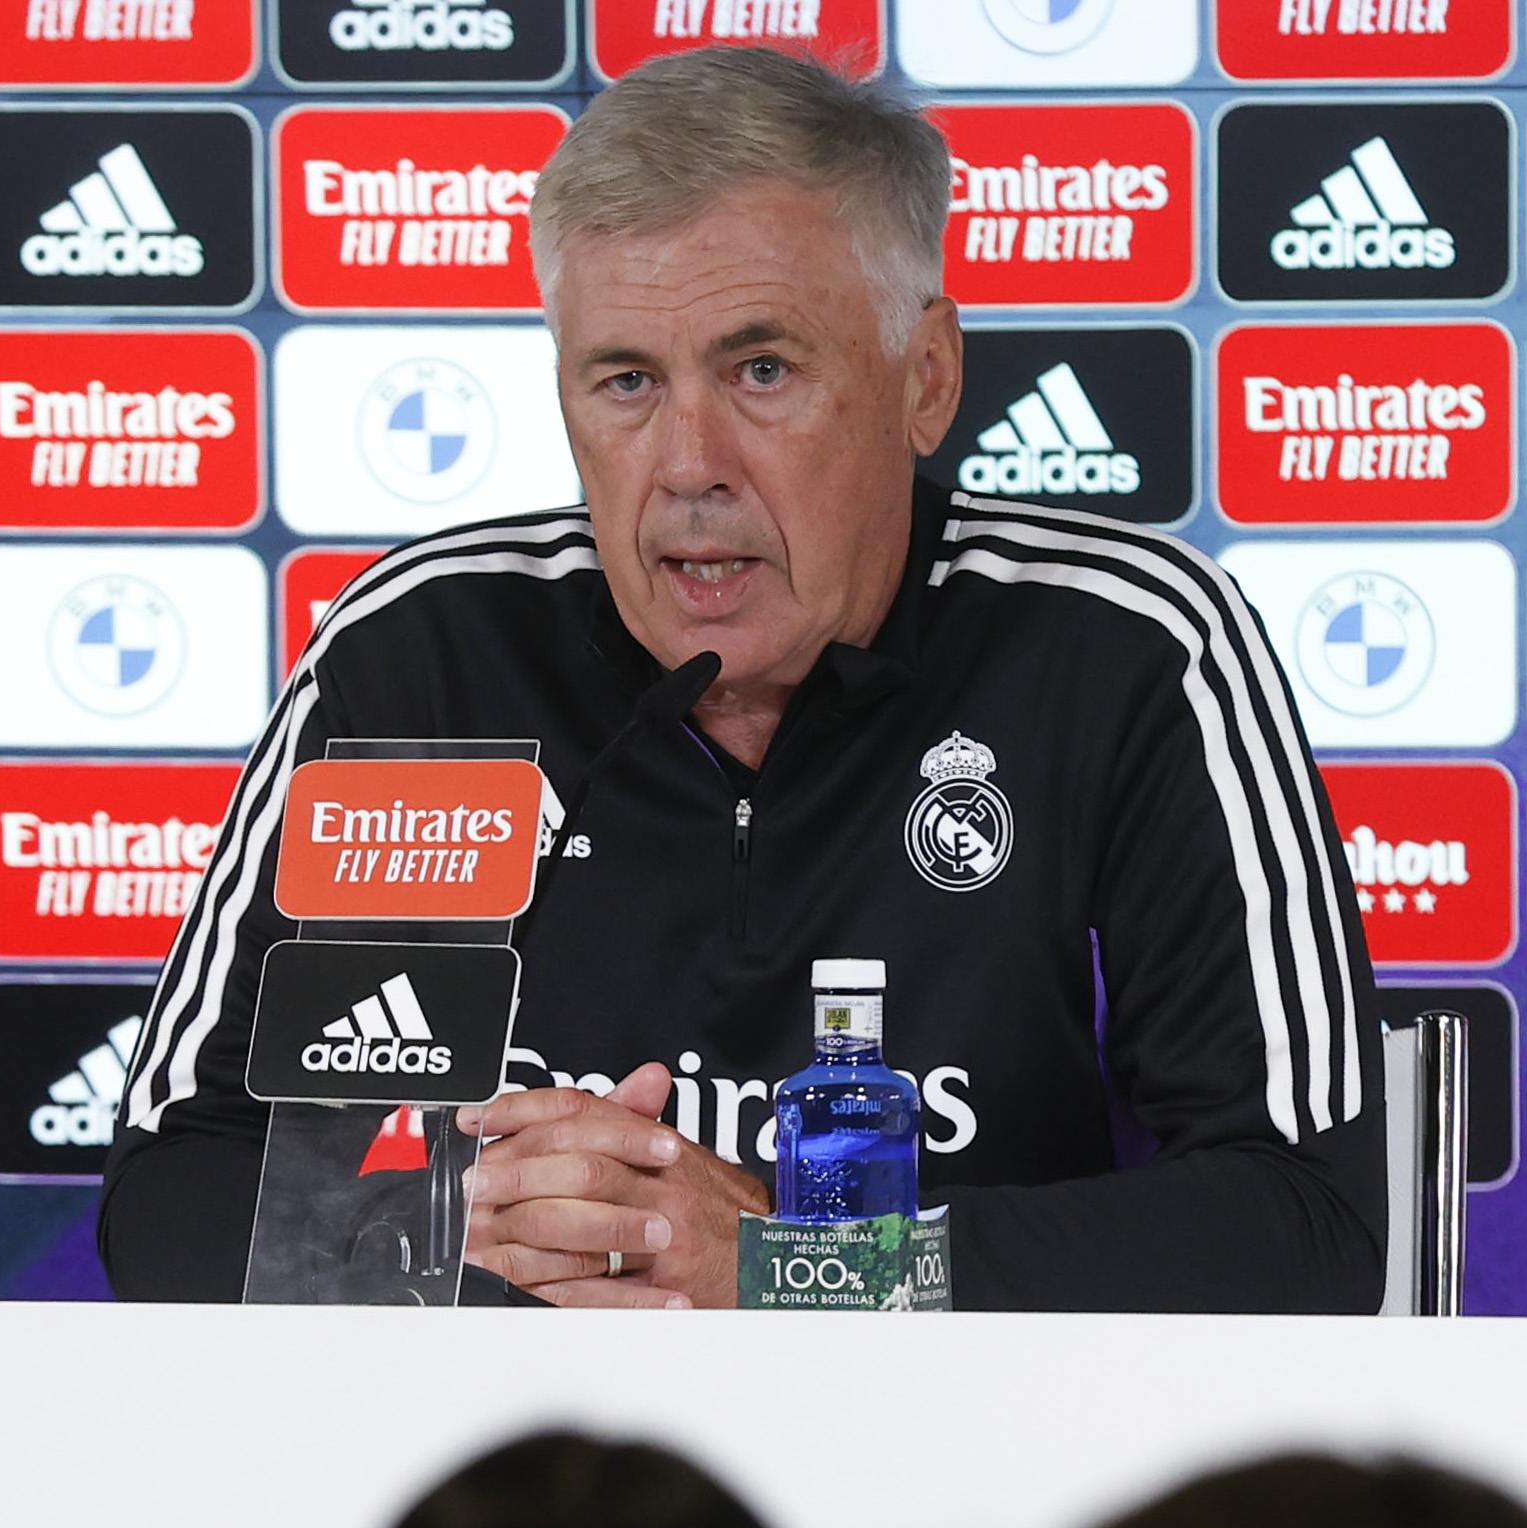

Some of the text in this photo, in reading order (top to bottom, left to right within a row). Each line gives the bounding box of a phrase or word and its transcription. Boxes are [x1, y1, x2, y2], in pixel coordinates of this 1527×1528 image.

[330, 0, 513, 50] adidas
[21, 226, 204, 276] adidas
[340, 220, 511, 266] FLY BETTER
[965, 215, 1133, 261] FLY BETTER
[1271, 219, 1455, 269] adidas
[1244, 374, 1485, 431] Emirates
[31, 441, 200, 487] FLY BETTER
[958, 447, 1139, 495] adidas
[1280, 435, 1450, 480] FLY BETTER
[1, 812, 223, 868] Emirate
[310, 800, 513, 844] Emirates
[333, 849, 480, 884] FLY BETTER
[1345, 826, 1469, 885] hou
[37, 872, 90, 916] FLY
[301, 1036, 453, 1075] adidas
[29, 1097, 117, 1146] adi
[762, 1231, 874, 1243] NUESTRAS BOTELLAS
[794, 1244, 839, 1255] HECHAS
[771, 1257, 865, 1290] 100%
[762, 1292, 875, 1305] DE OTRAS BOTELLAS
